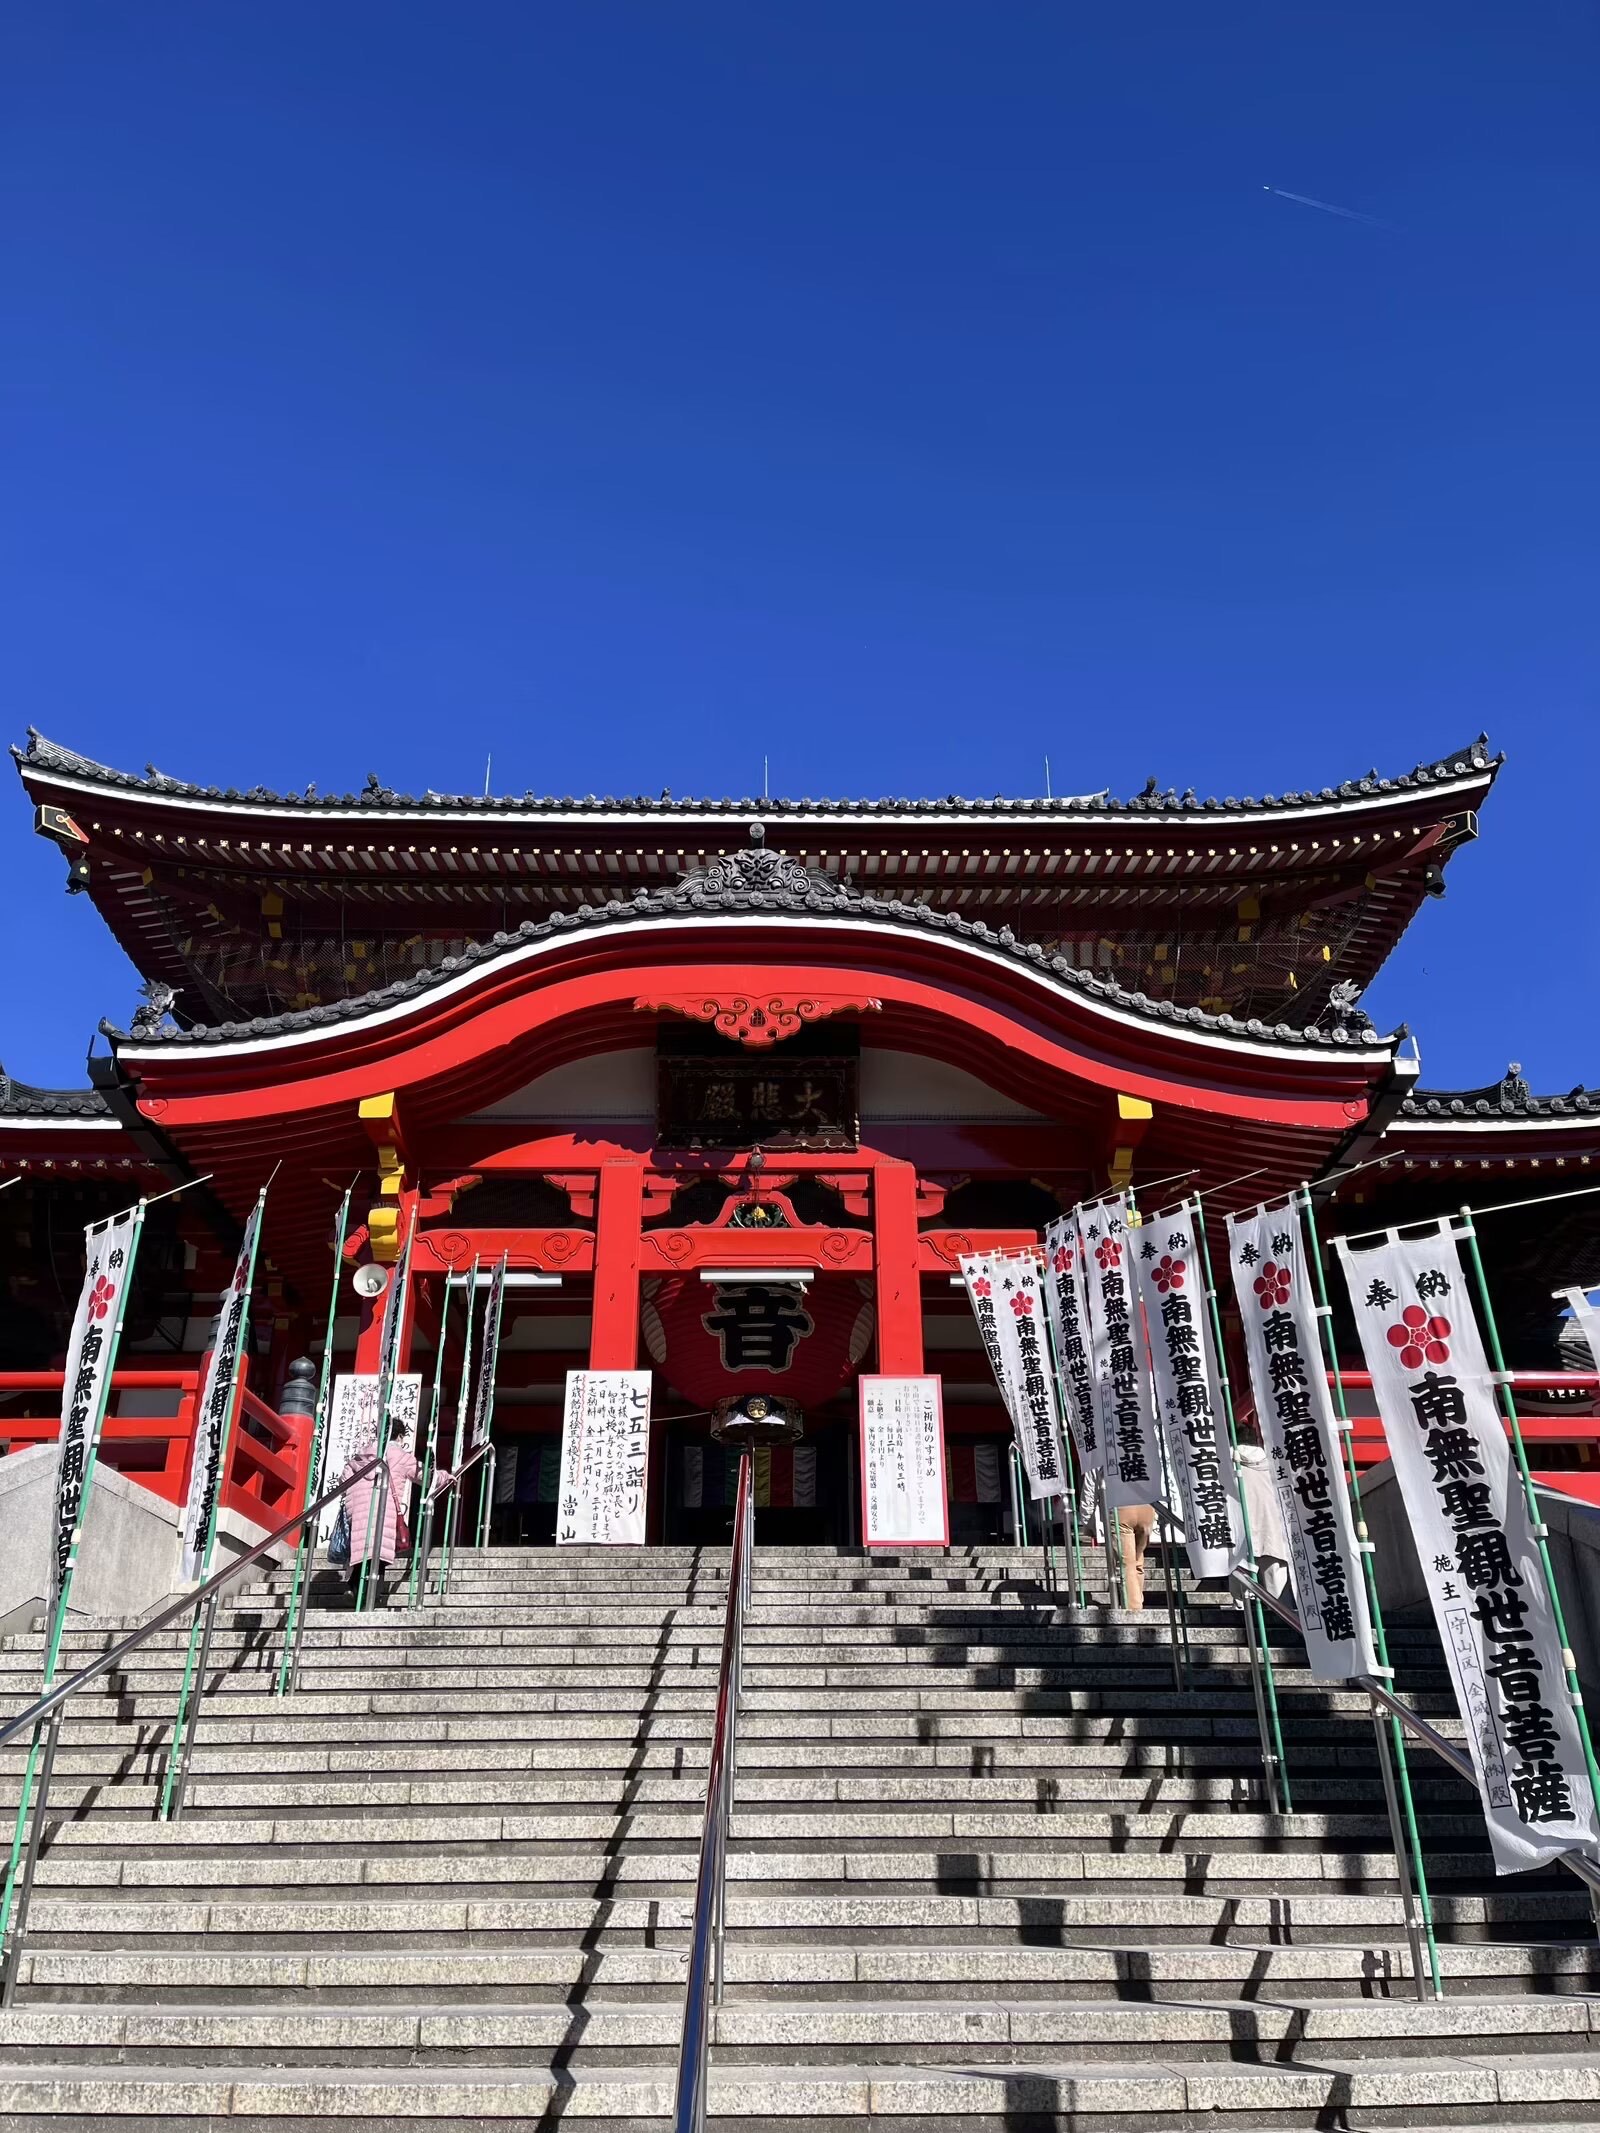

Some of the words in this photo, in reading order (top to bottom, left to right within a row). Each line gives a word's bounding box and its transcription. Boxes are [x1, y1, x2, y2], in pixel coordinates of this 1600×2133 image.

[1087, 1219, 1123, 1241] 奉納
[1140, 1231, 1188, 1261] 奉納
[1239, 1232, 1294, 1268] 奉納
[88, 1248, 124, 1280] 奉納
[1002, 1275, 1035, 1292] 奉納
[1365, 1269, 1451, 1311] 奉納
[1056, 1272, 1097, 1453] 南無聖観世音菩薩
[1101, 1270, 1149, 1482] 南無聖観世音菩薩
[1016, 1315, 1058, 1480] 南無聖観世音菩薩
[1161, 1292, 1235, 1550] 南無聖観世音菩薩
[1165, 1398, 1178, 1426] 施主
[613, 1377, 629, 1518] お子様の健やかなる成長と
[625, 1388, 648, 1515] 七五三詣り
[923, 1400, 936, 1477] ご祈祷のすすめ
[1271, 1446, 1289, 1481] 施主
[1262, 1309, 1356, 1642] 南無聖観世音菩薩
[1409, 1371, 1576, 1824] 南無聖観世音菩薩
[1433, 1555, 1461, 1602] 施主
[1451, 1616, 1478, 1670] 守山区
